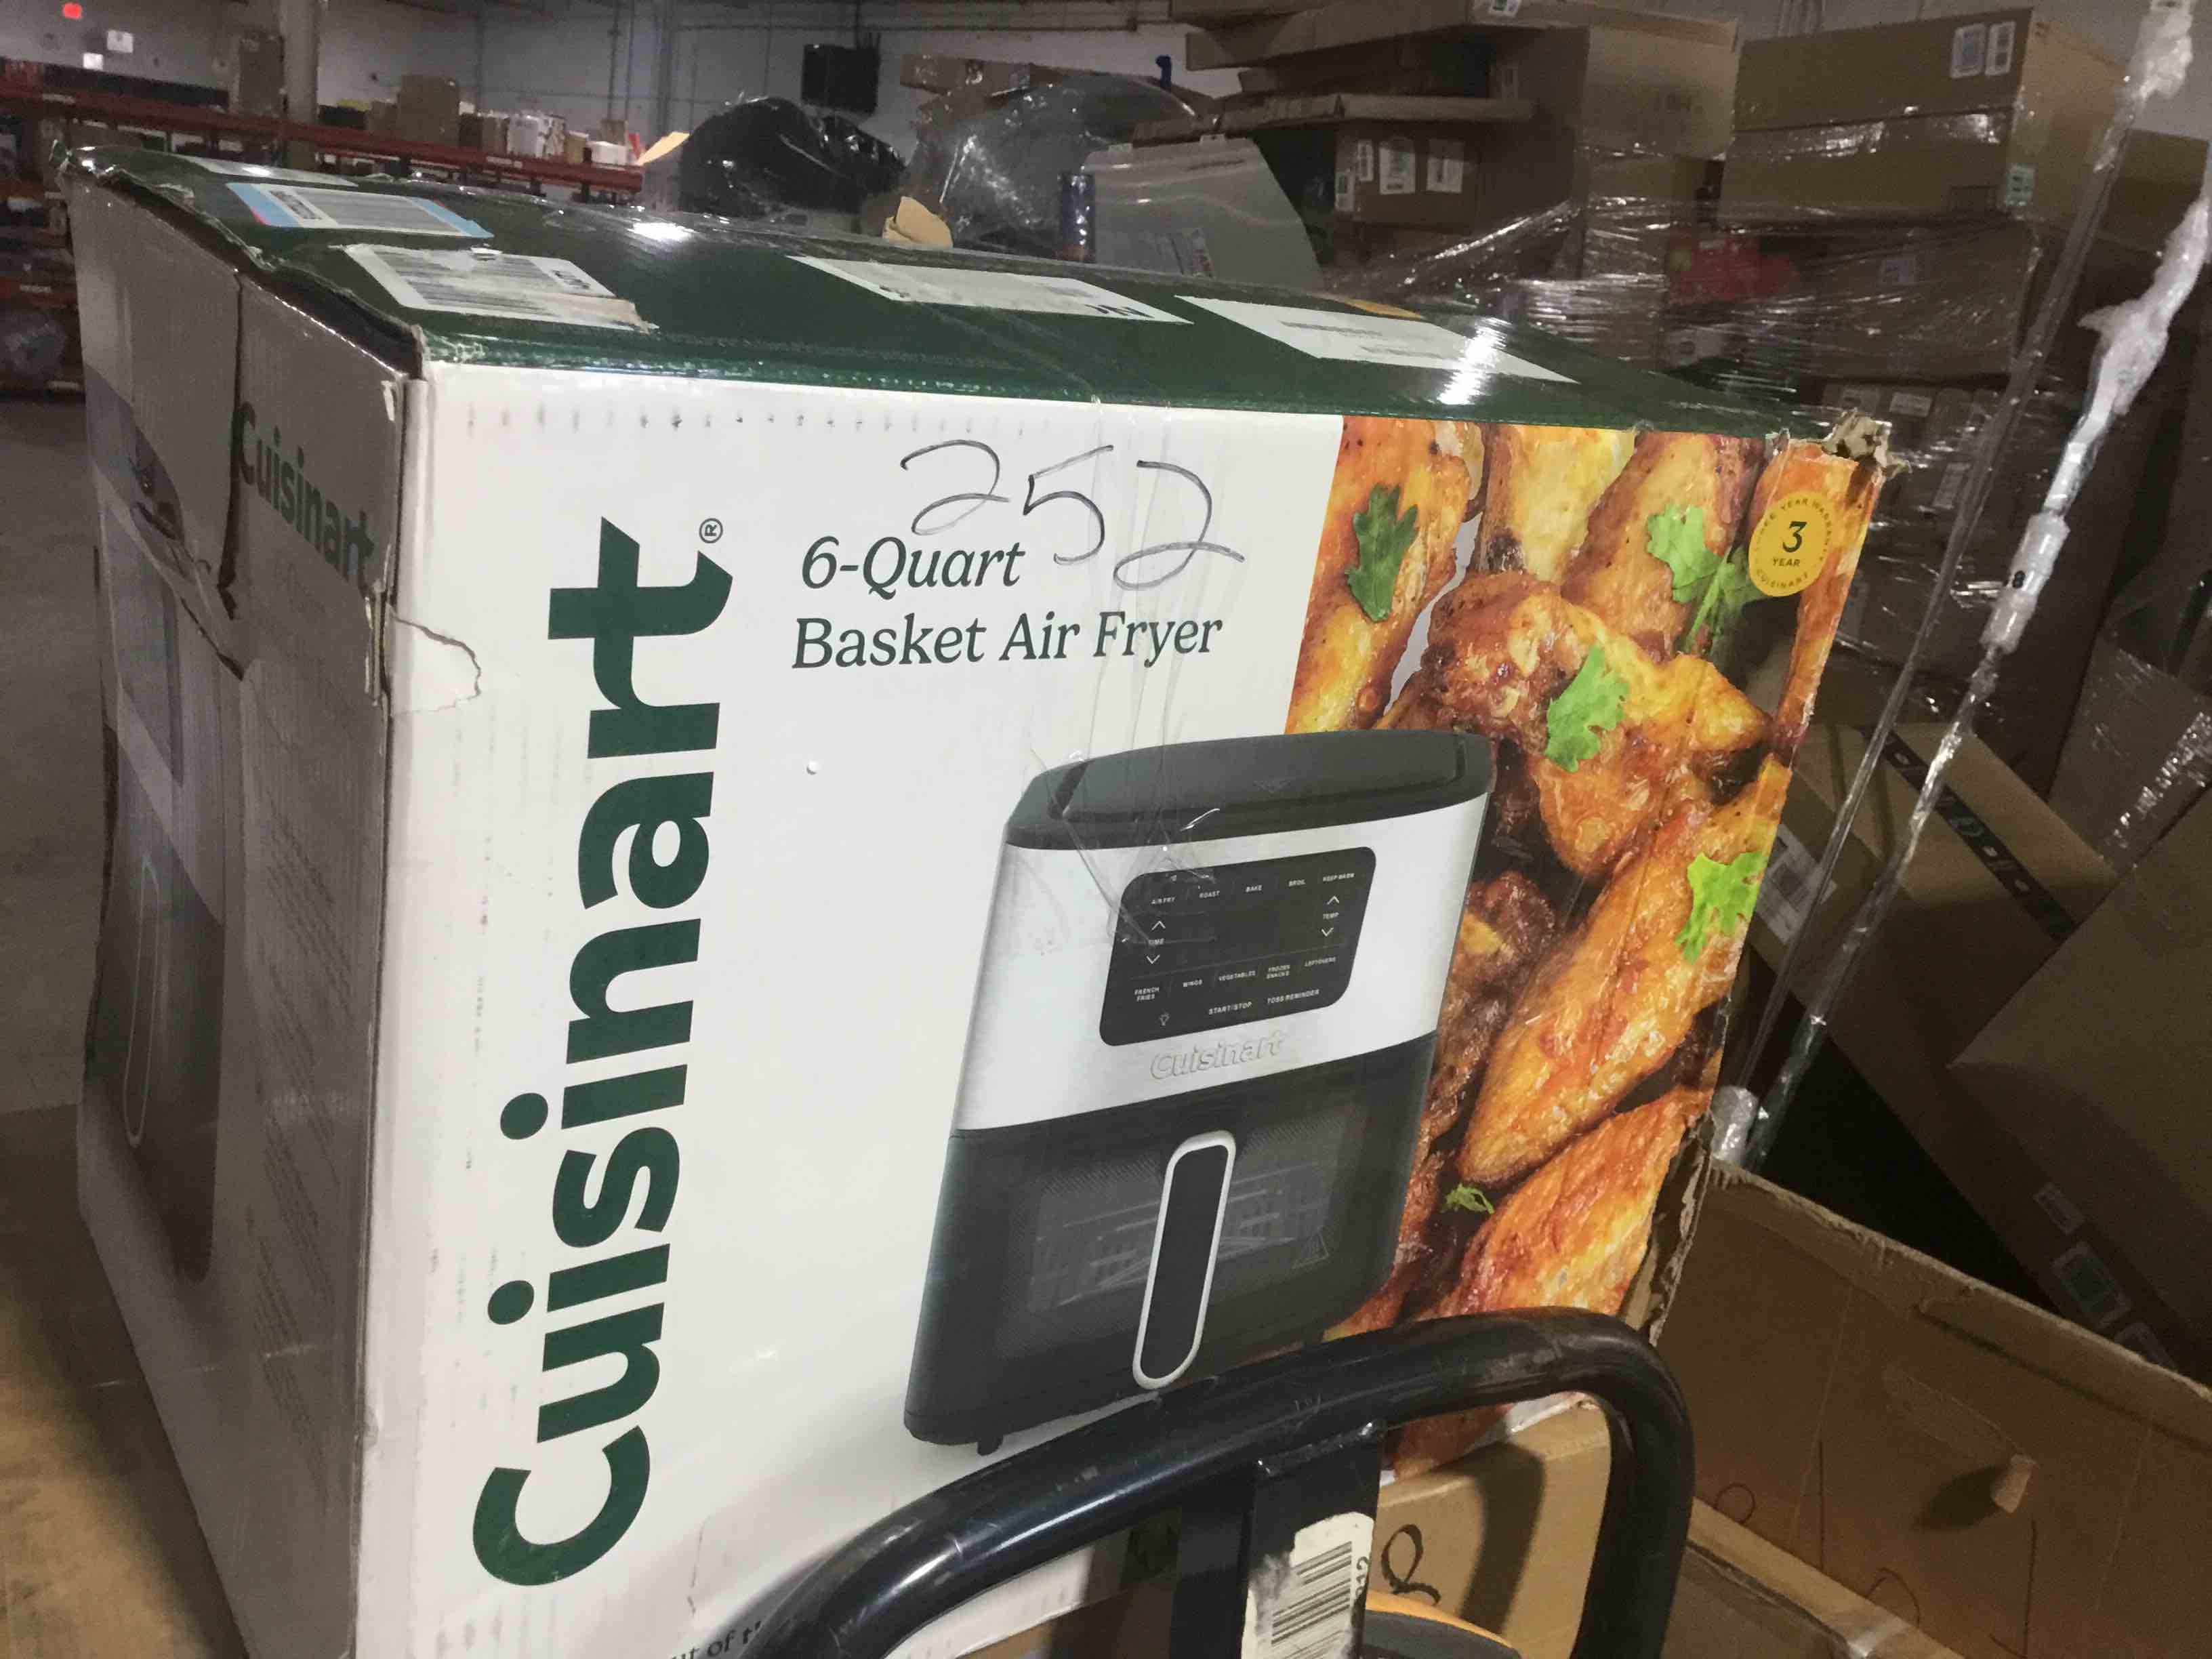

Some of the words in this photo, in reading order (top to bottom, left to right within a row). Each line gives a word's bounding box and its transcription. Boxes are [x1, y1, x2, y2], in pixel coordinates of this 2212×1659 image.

[232, 401, 374, 598] Cuisinart
[899, 438, 1246, 592] 252
[1772, 557, 1801, 567] YEAR
[1782, 520, 1807, 553] 3
[800, 535, 1026, 600] 6-Quart
[792, 612, 987, 669] Basket
[999, 611, 1080, 662] Air
[1093, 610, 1223, 669] Fryer
[1245, 884, 1263, 893] BAKE
[1134, 987, 1160, 996] FRENCH
[473, 516, 733, 1586] Cuisinart
[1149, 1029, 1286, 1080] Cuisinart
[707, 1629, 737, 1658] of
